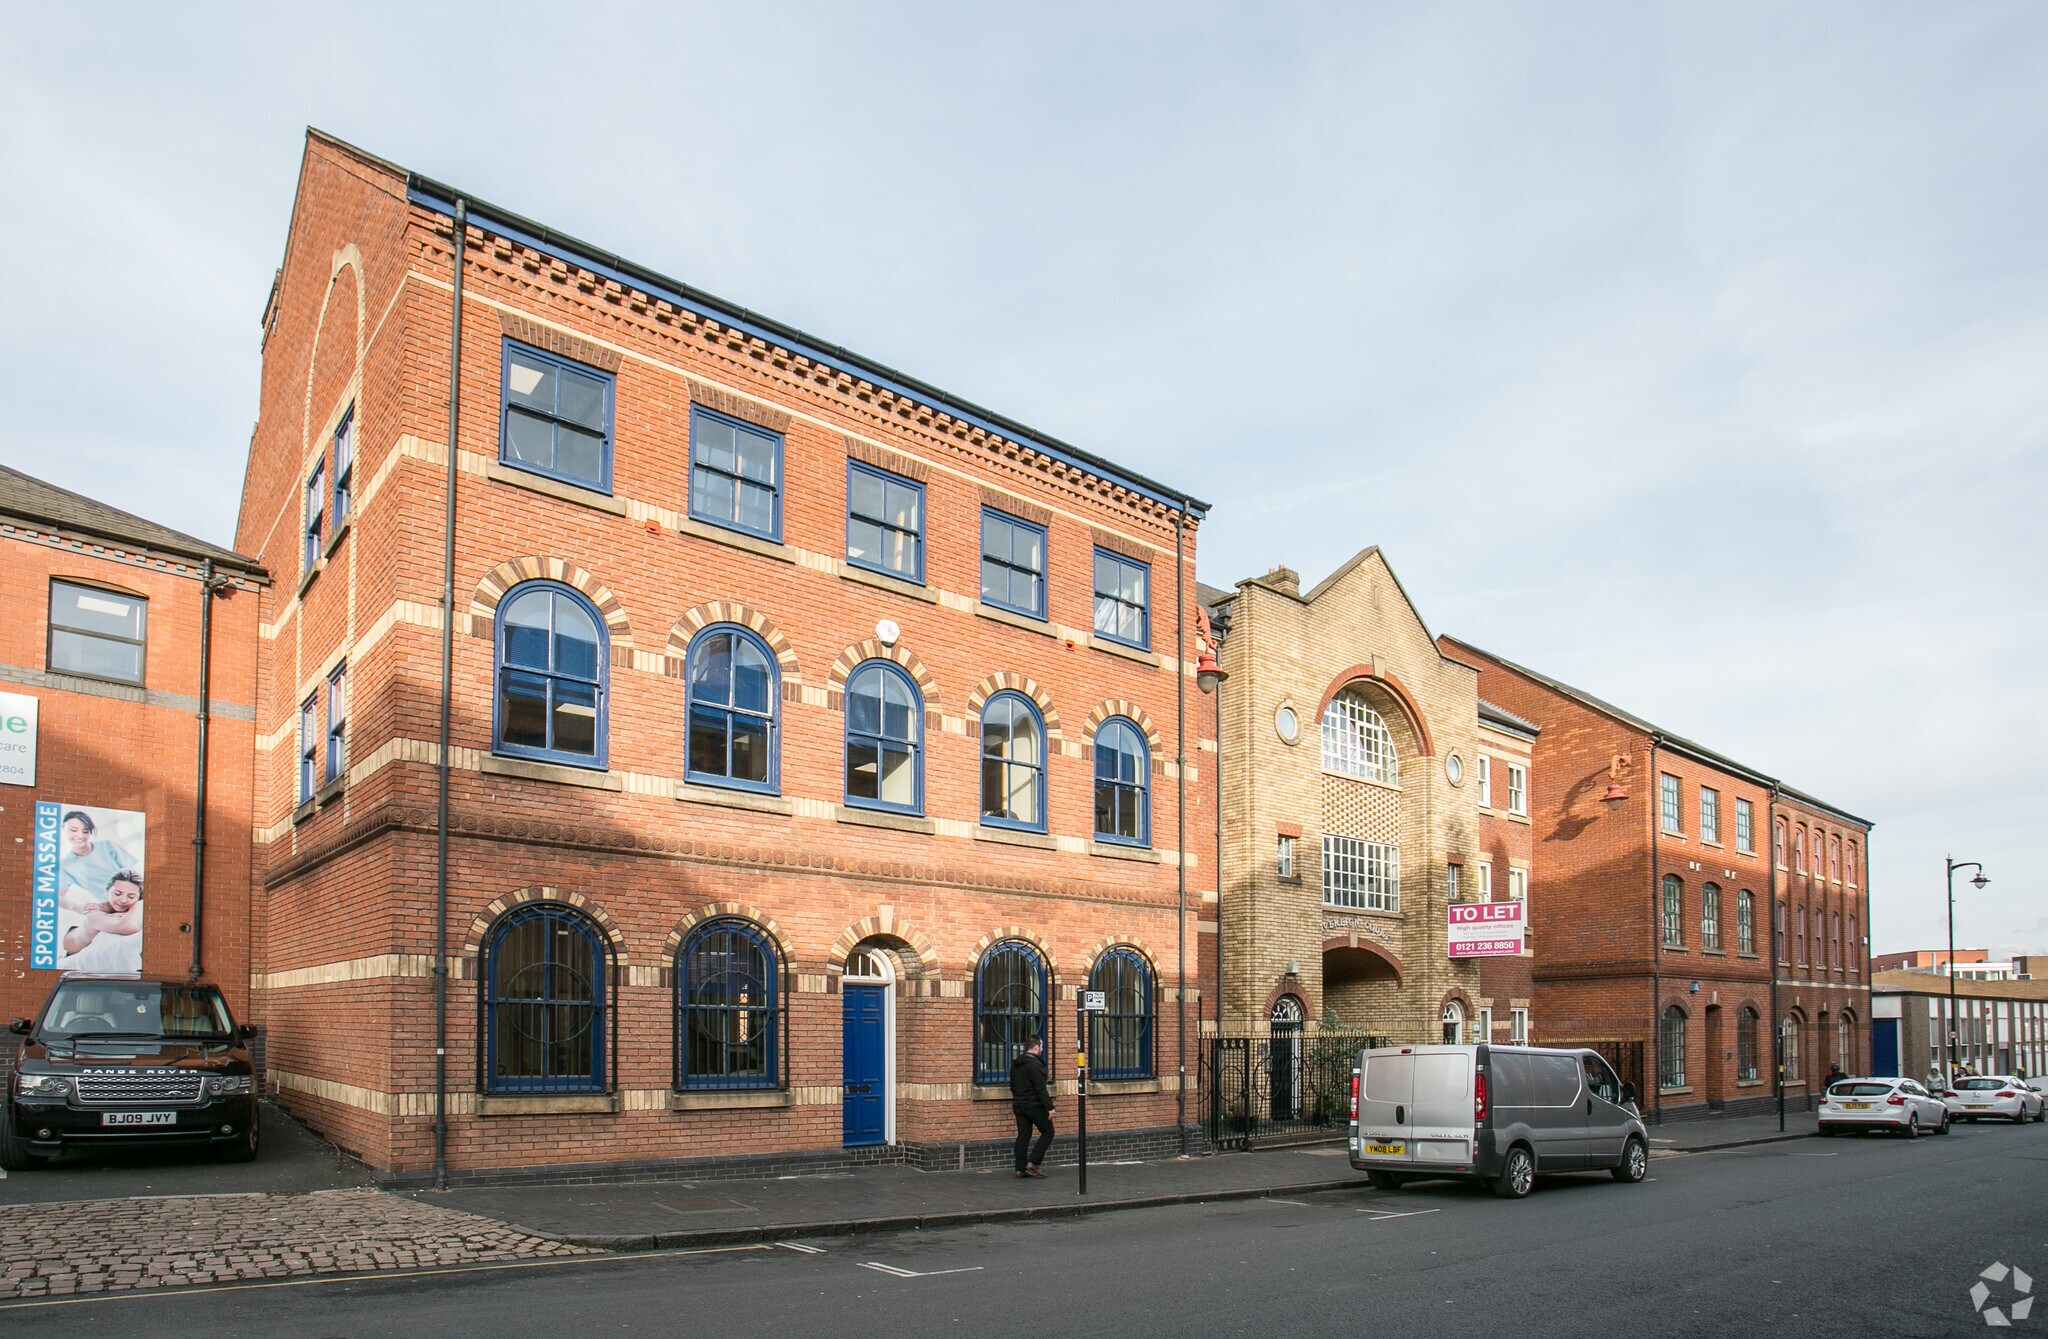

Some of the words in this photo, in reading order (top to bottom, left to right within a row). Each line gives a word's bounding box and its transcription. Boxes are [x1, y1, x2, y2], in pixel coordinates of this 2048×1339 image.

[0, 714, 28, 734] e
[37, 805, 58, 893] MASSAGE
[1452, 907, 1478, 921] TO
[1483, 905, 1518, 920] LET
[34, 898, 55, 966] SPORTS
[1456, 943, 1475, 951] 0121
[1477, 942, 1493, 950] 236
[1494, 941, 1515, 949] 8850
[108, 1114, 143, 1124] BJ09
[146, 1113, 171, 1123] JVY
